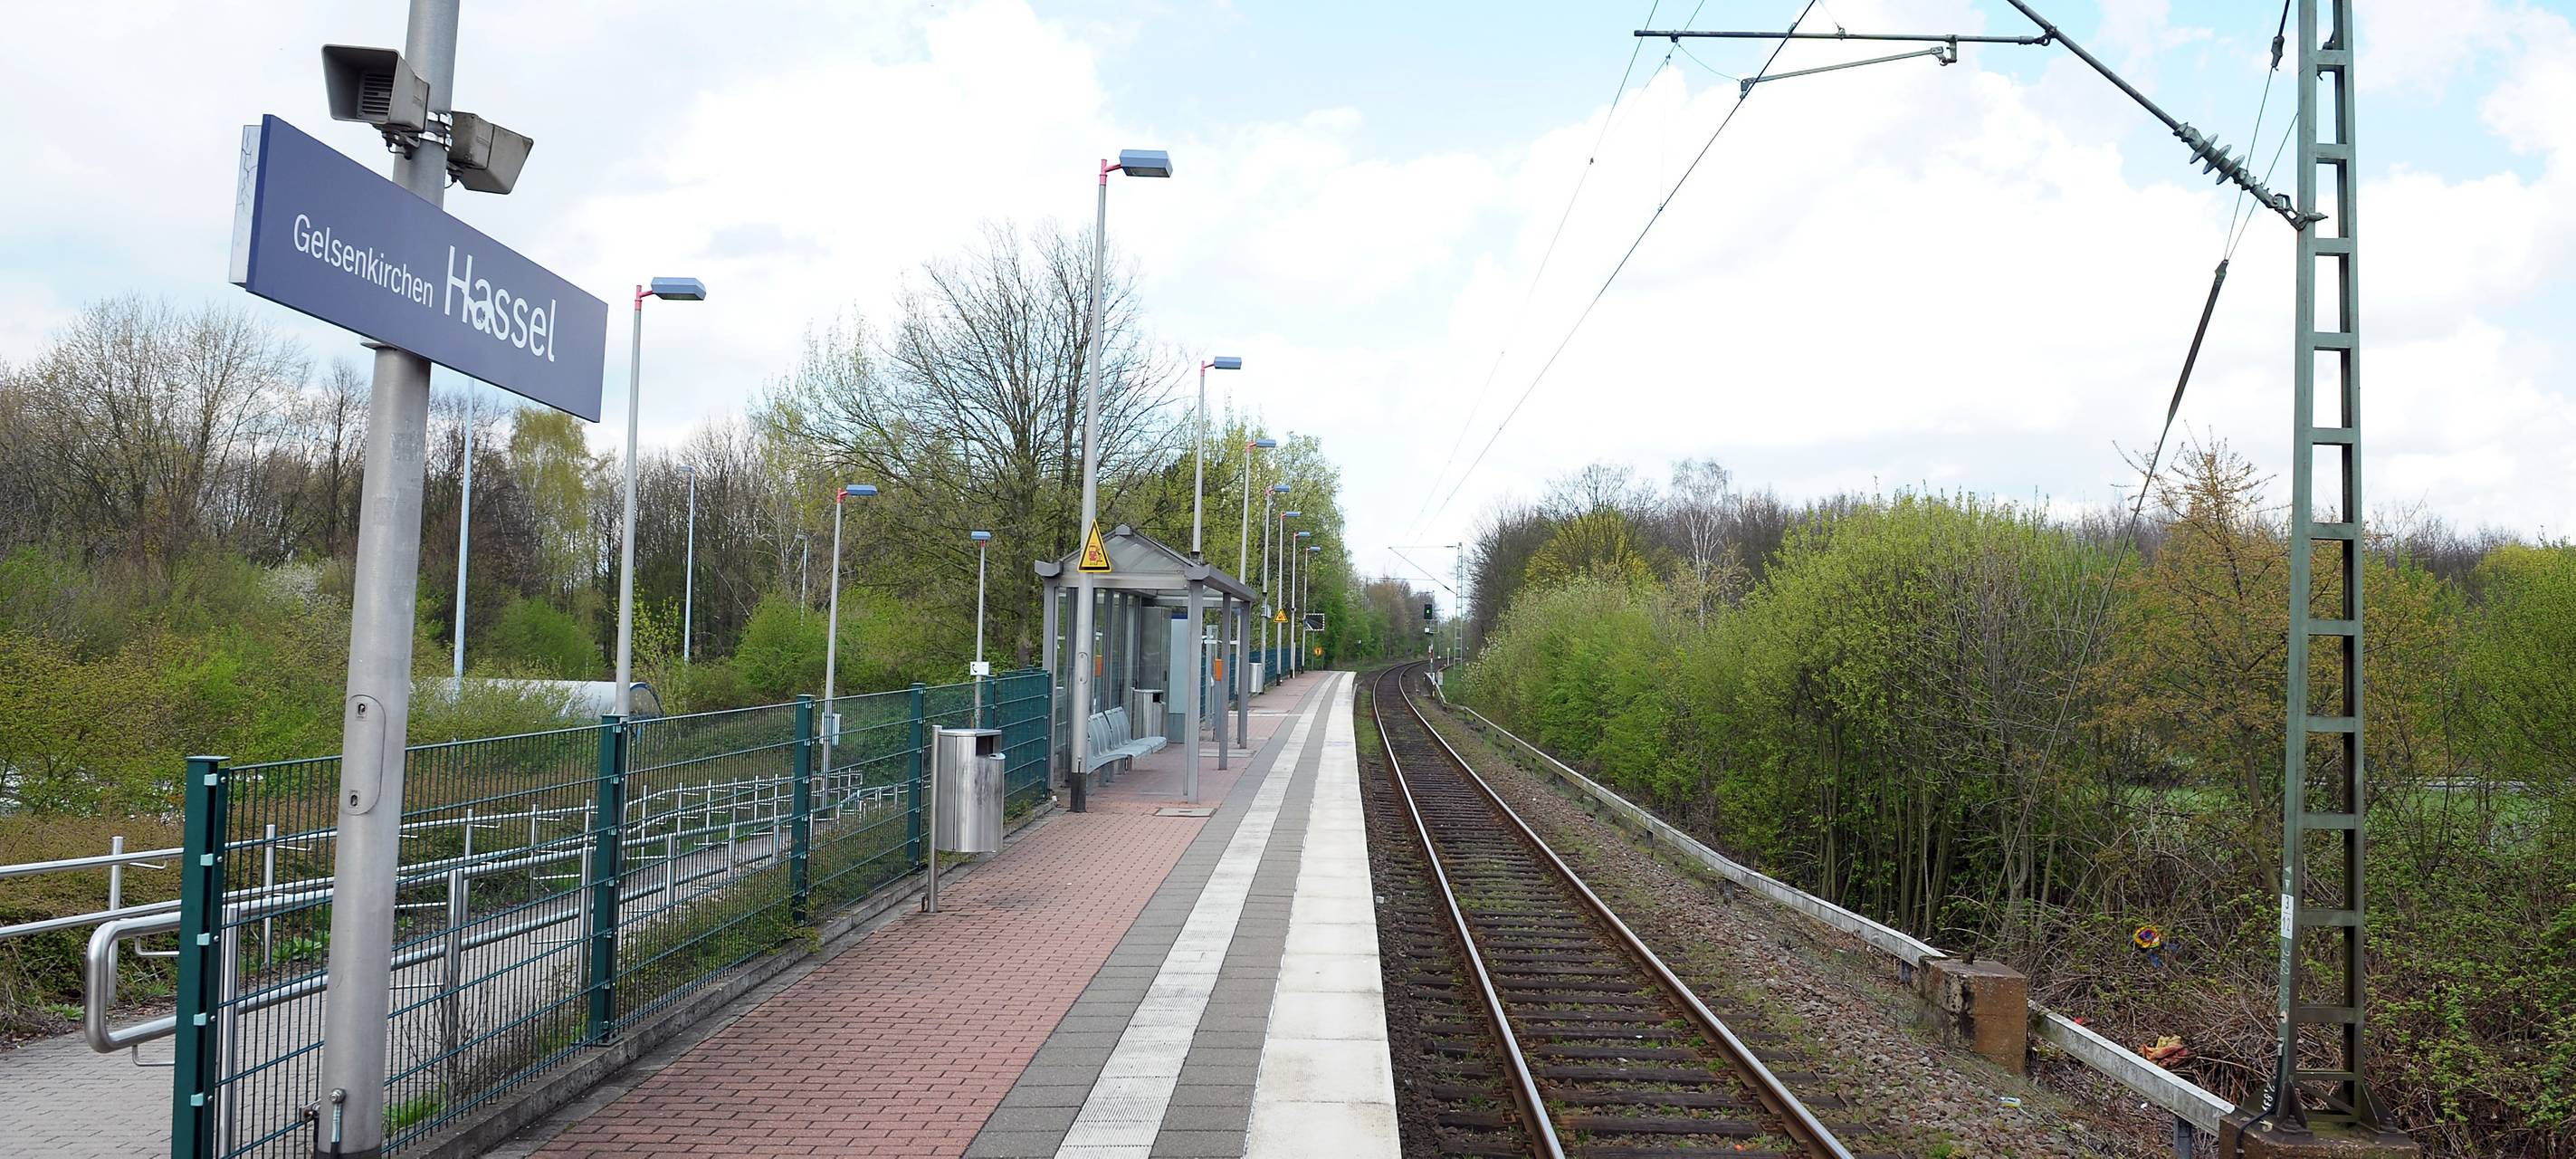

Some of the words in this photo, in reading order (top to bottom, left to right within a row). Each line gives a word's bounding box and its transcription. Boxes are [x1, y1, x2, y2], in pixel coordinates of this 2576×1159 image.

[293, 213, 434, 308] Gelsenkirchen
[444, 244, 557, 362] Hassel
[2283, 916, 2291, 932] 12
